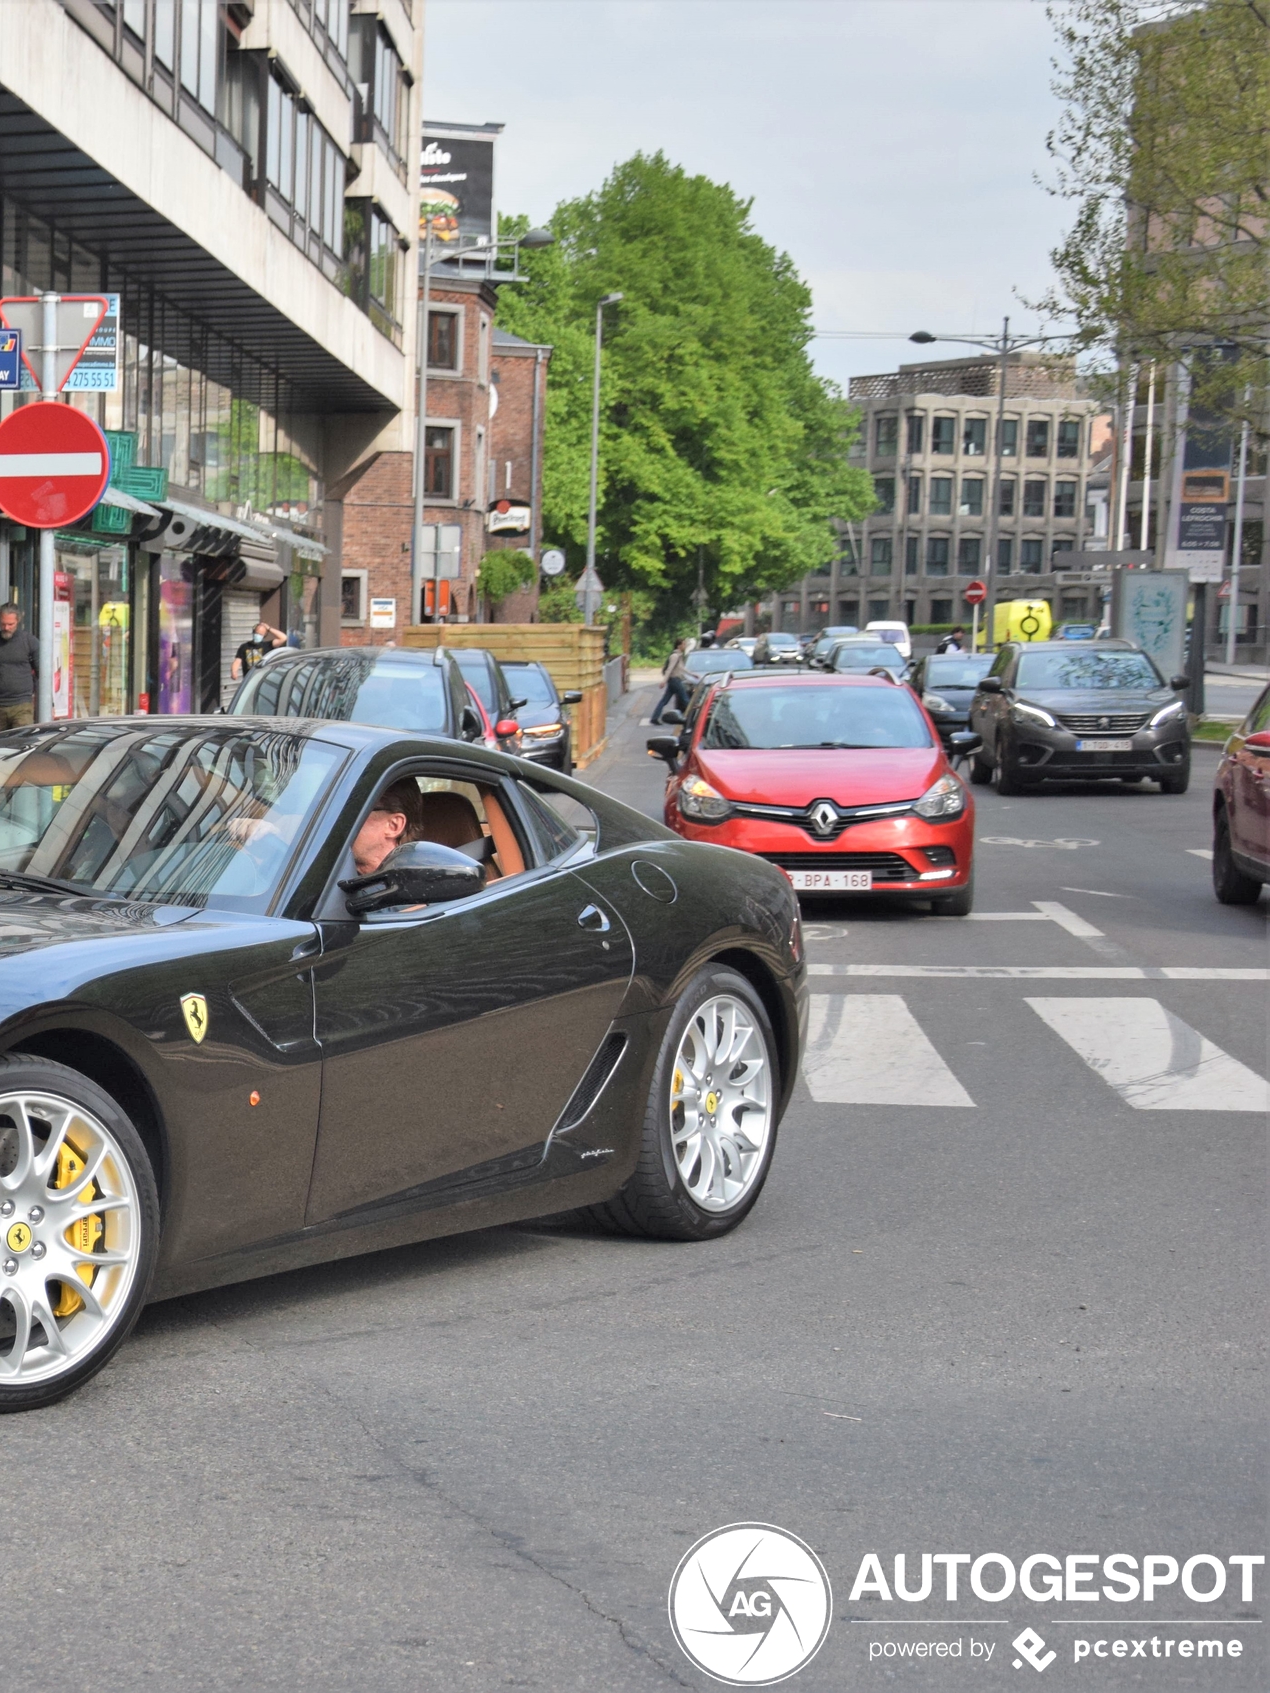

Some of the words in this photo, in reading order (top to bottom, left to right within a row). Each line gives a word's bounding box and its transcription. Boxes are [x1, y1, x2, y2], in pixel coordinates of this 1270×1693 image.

[73, 372, 89, 387] 275
[91, 372, 102, 387] 55
[104, 372, 115, 387] 51
